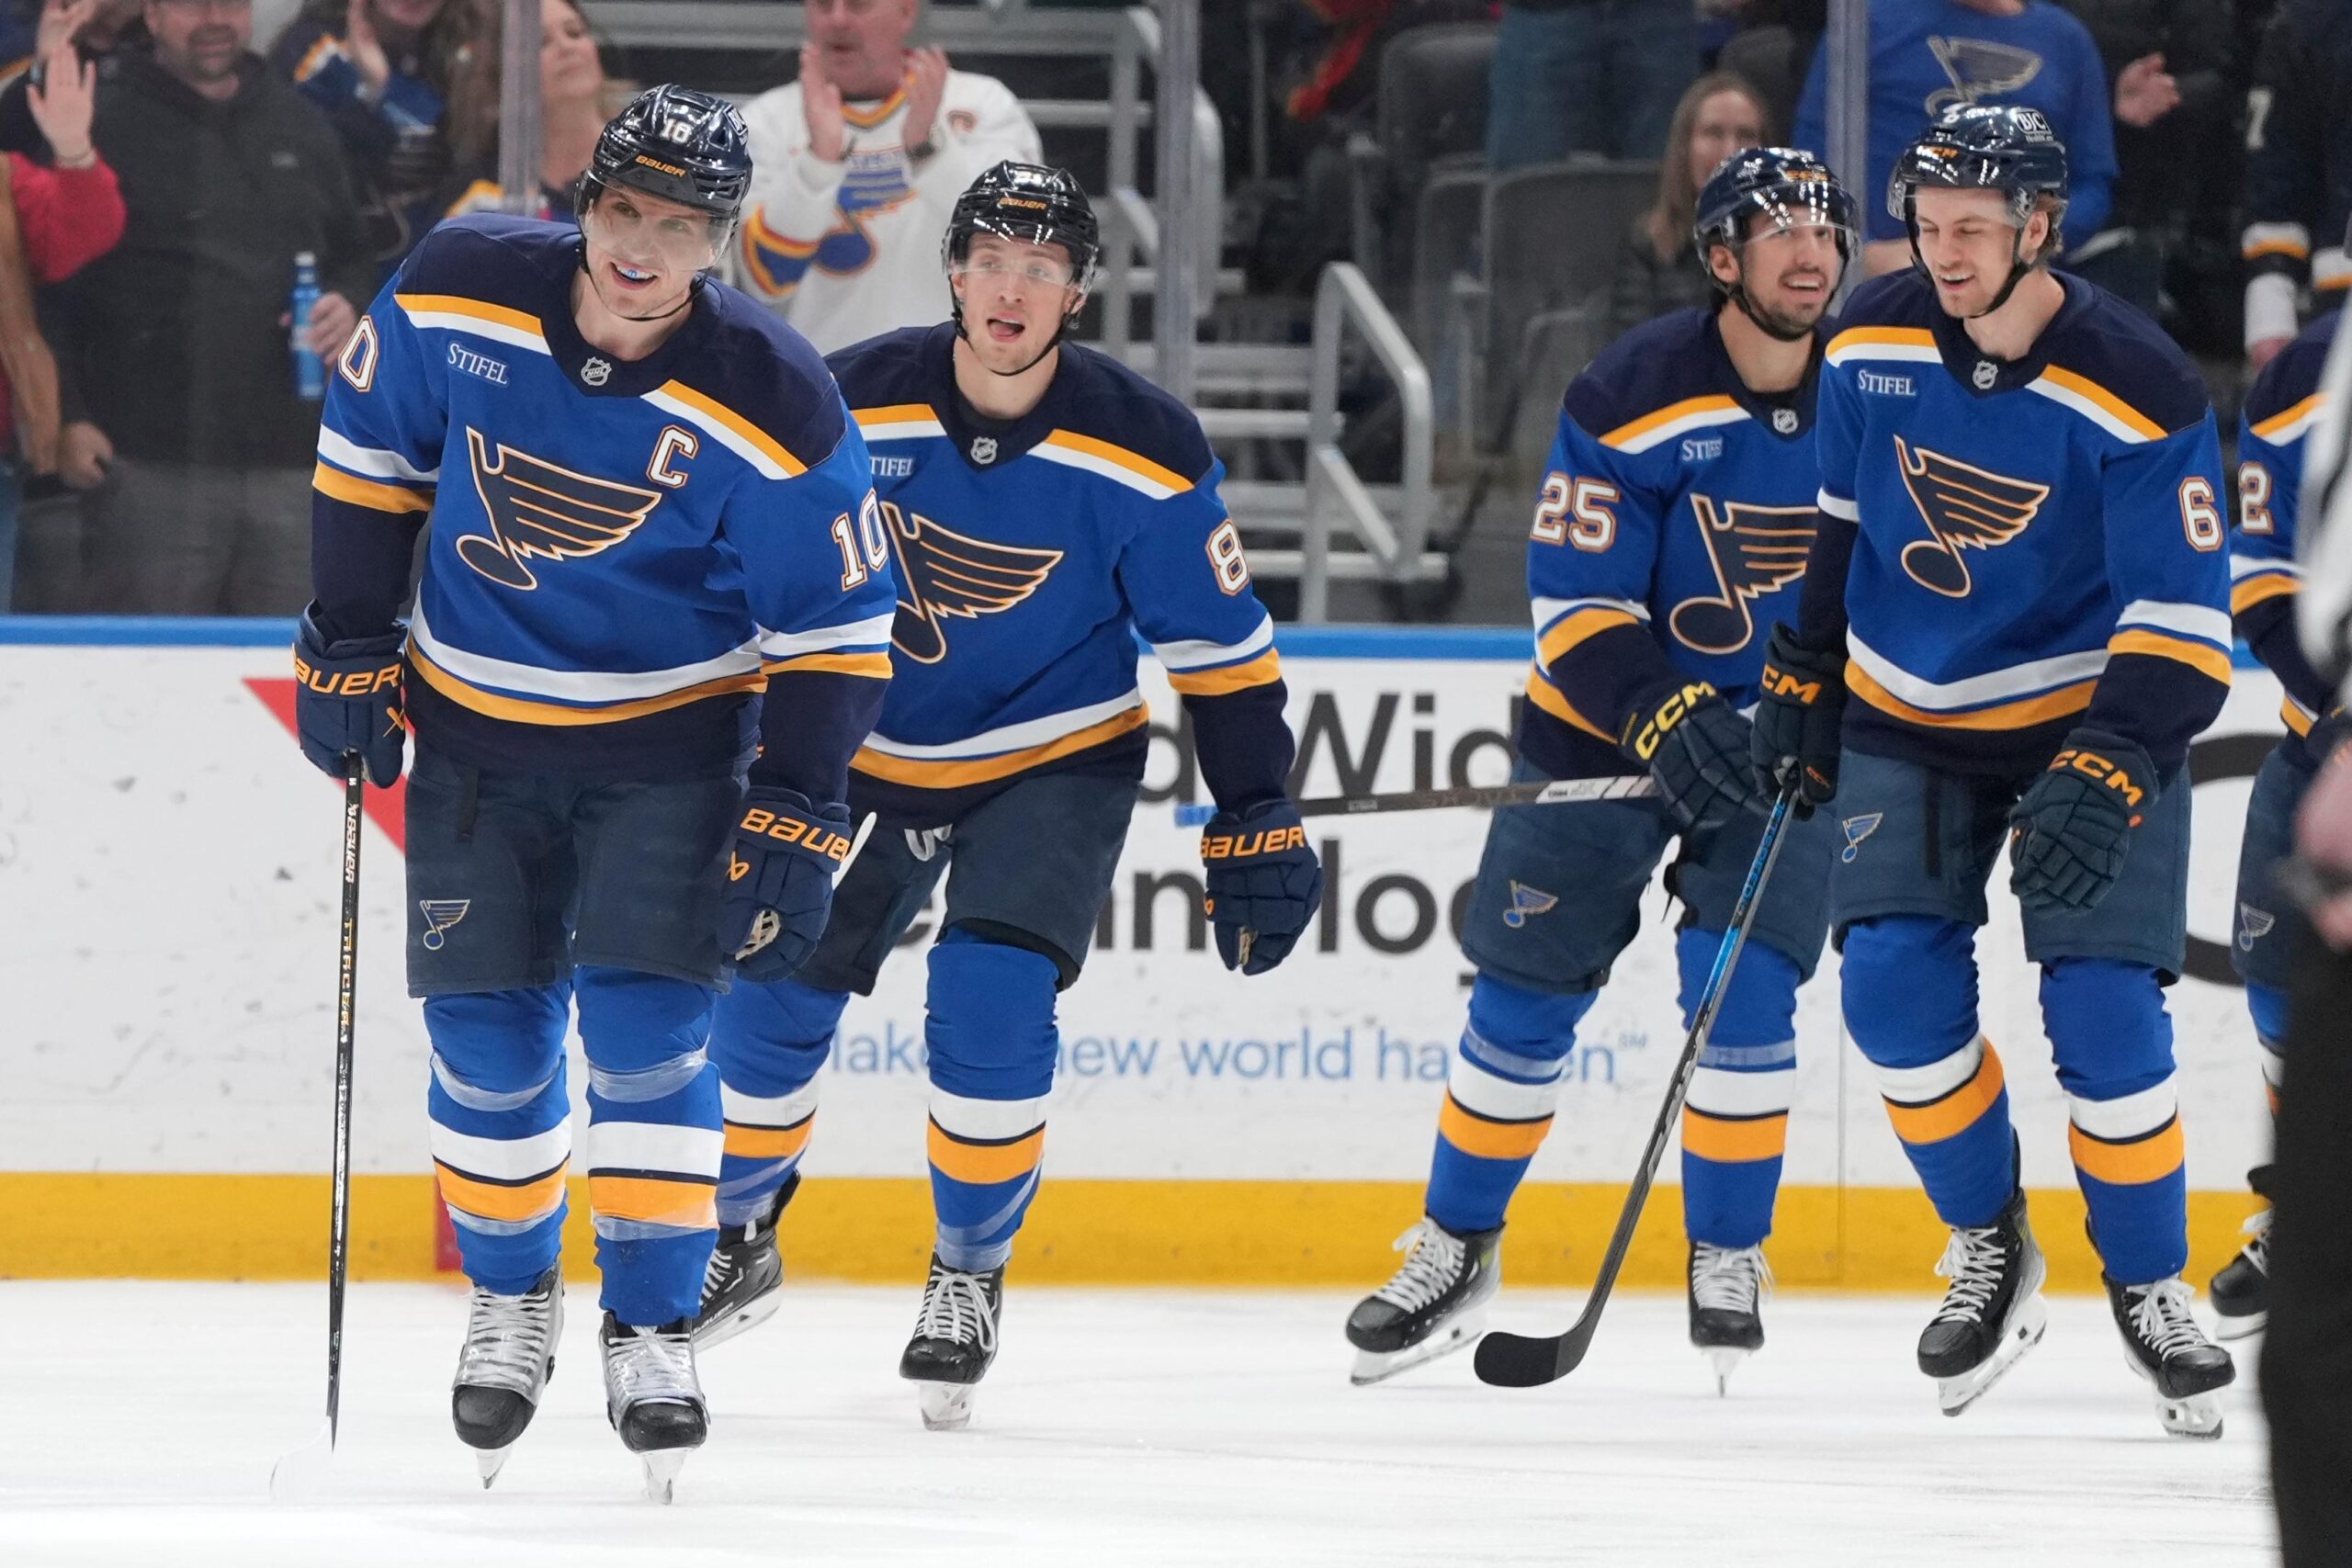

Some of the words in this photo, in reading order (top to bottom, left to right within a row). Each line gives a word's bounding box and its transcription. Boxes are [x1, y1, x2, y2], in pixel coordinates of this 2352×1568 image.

[634, 154, 686, 177] BAUER
[447, 342, 509, 385] STIFEL
[1857, 368, 1917, 397] STIFEL
[645, 423, 699, 490] C
[868, 455, 915, 477] TIFEL
[1529, 470, 1622, 554] 25
[2177, 476, 2224, 552] 6
[2237, 461, 2275, 536] 2
[831, 487, 889, 592] 10
[1204, 517, 1251, 597] 8
[293, 641, 402, 696] AUER
[1761, 661, 1823, 705] CM
[1283, 691, 1527, 808] Wid
[1634, 681, 1717, 761] CCM
[2046, 749, 2144, 807] CCM
[740, 807, 852, 863] BAUE
[1057, 1037, 1160, 1077] ew
[1179, 1026, 1353, 1079] world
